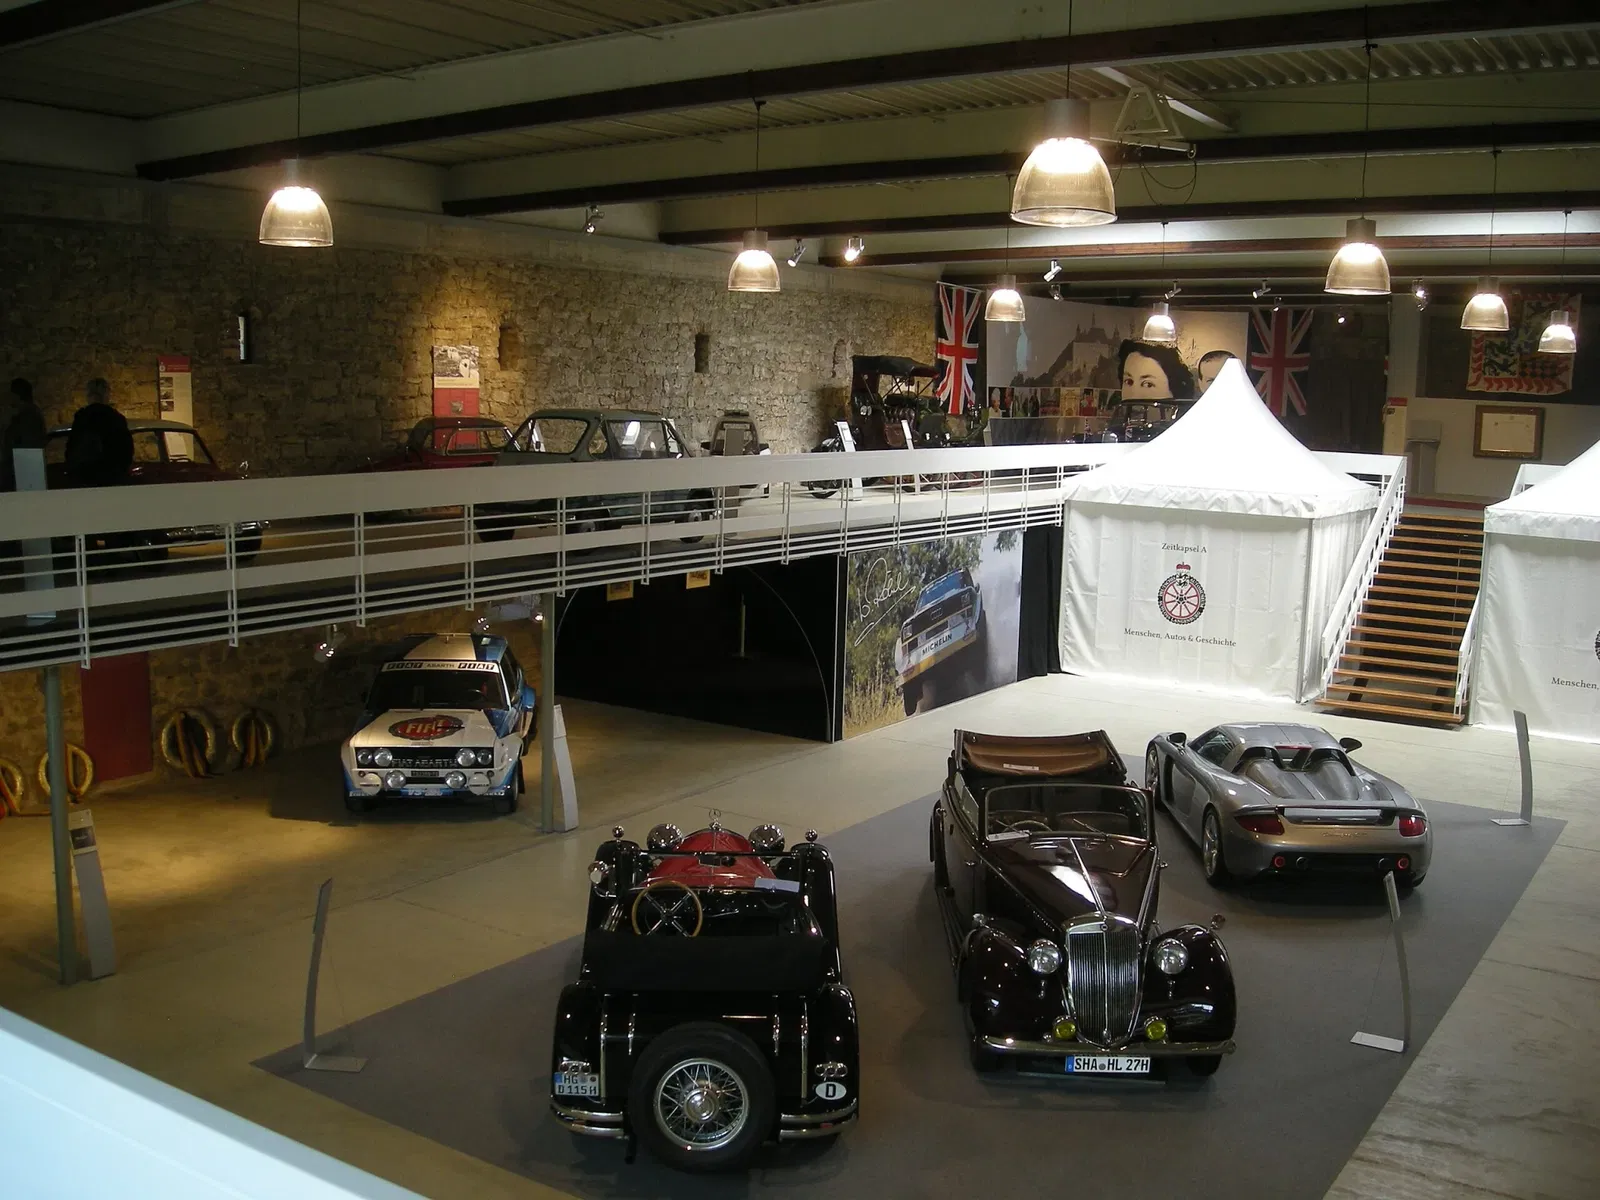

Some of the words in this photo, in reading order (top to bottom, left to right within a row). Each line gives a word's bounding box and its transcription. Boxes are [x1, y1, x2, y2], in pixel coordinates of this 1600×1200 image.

[1161, 543, 1199, 554] Zeitkapsel
[922, 633, 953, 655] MICHELIN
[1123, 627, 1163, 640] Menschen,
[1164, 632, 1186, 641] Autos
[1195, 635, 1237, 647] Geschichte
[458, 662, 495, 670] FIAT
[1551, 676, 1600, 691] Menschen,
[1074, 1057, 1098, 1070] SHA
[1107, 1058, 1122, 1071] HL
[1126, 1058, 1149, 1071] 27H
[563, 1075, 578, 1084] HG
[825, 1083, 837, 1098] D
